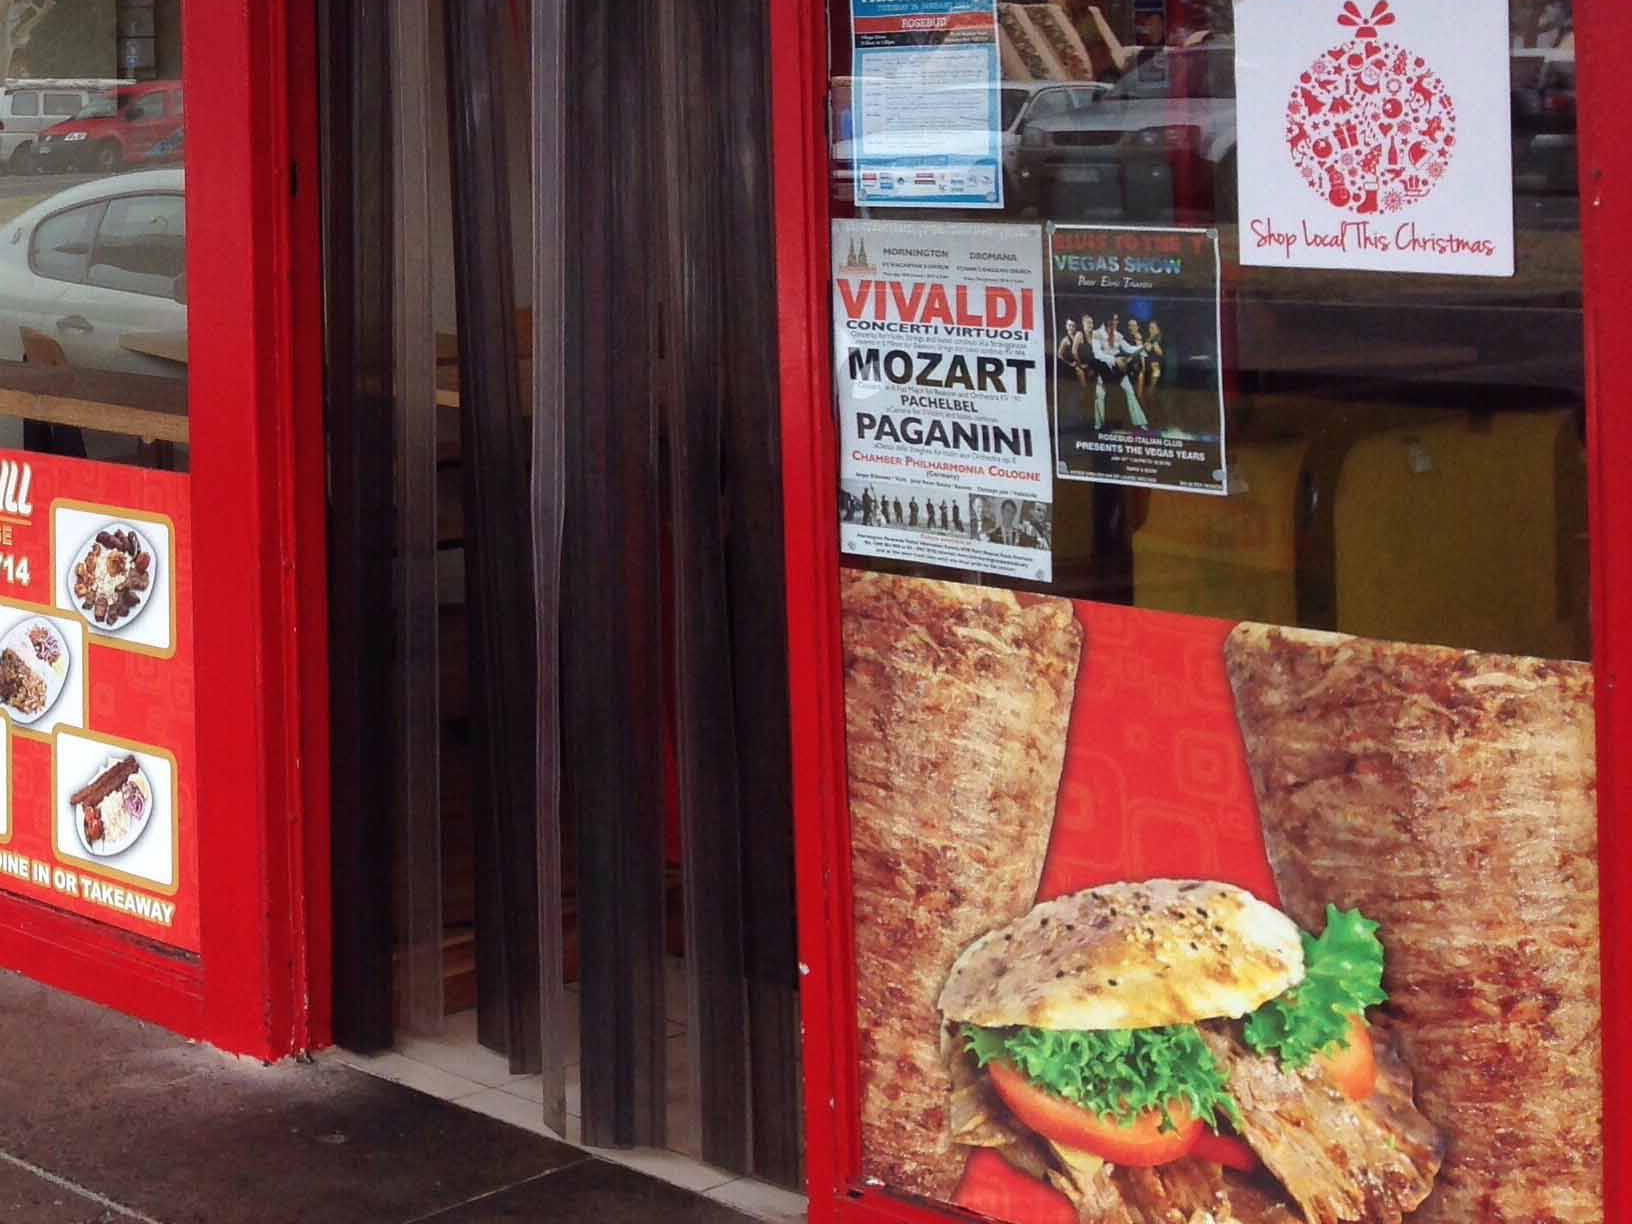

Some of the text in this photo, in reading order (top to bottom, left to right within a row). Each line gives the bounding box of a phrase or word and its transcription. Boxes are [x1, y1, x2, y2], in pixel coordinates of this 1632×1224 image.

[1250, 218, 1496, 258] Shop Local This Christmas
[1053, 255, 1183, 274] VEGAS SHOW
[836, 277, 1034, 330] VIVALDI
[846, 319, 939, 336] CONCERTI
[944, 326, 1030, 342] VIRTUOSI
[847, 346, 1036, 395] MOZART
[901, 394, 978, 413] PACHELBEL
[856, 411, 1034, 457] PAGANINI
[1075, 441, 1123, 453] PRESENTS
[1125, 445, 1143, 456] THE
[1144, 446, 1174, 458] VEGAS
[1176, 450, 1206, 462] YEARS
[851, 450, 903, 466] CHAMBER
[988, 464, 1041, 482] COLOGNE
[31, 863, 52, 888] IN
[53, 870, 79, 896] OR
[79, 877, 176, 927] TAKEAWAY
